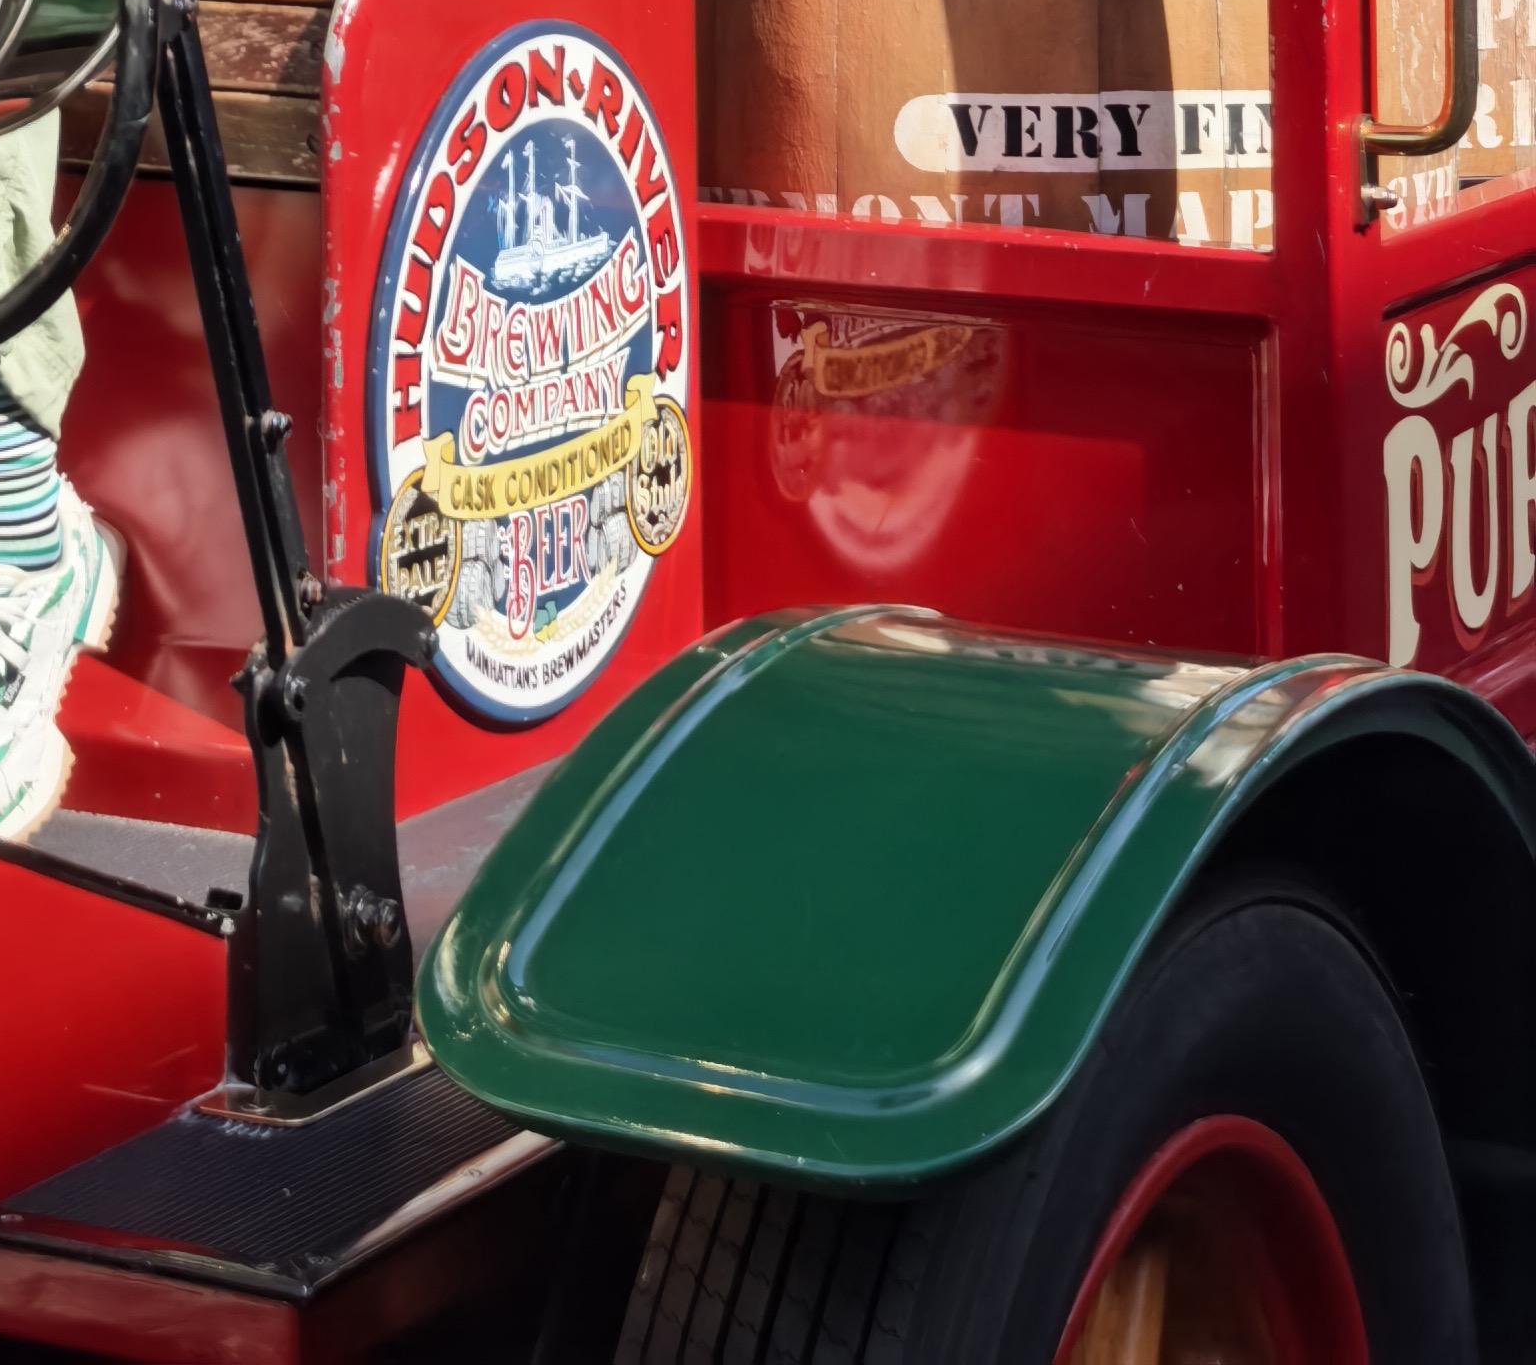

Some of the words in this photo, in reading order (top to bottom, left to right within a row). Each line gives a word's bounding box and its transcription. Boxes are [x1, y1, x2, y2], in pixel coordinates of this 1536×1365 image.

[947, 102, 1151, 159] VERY
[392, 43, 566, 451] HUDSON
[583, 53, 681, 382] RIVER
[436, 232, 648, 379] BREWING
[465, 352, 626, 459] COMPANY
[450, 473, 497, 513] CASK
[504, 418, 633, 507] CONDITIONED
[389, 511, 453, 561] EXTRA
[398, 553, 448, 600] PALE
[506, 496, 592, 641] BEER
[542, 578, 627, 686] BREWMASTERS
